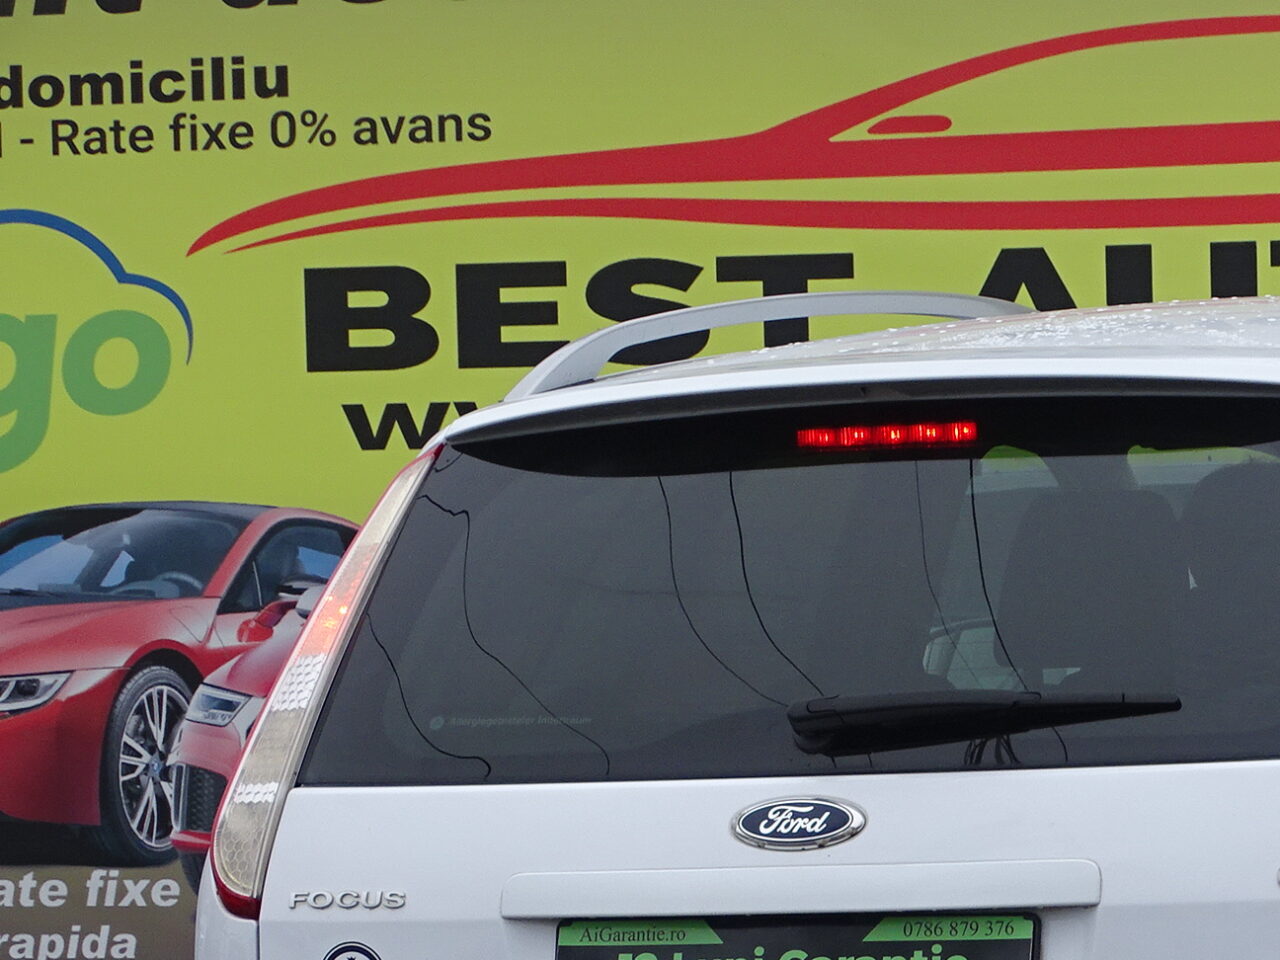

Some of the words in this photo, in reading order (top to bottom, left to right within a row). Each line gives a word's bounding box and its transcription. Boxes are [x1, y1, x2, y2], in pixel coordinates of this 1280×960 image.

[51, 118, 154, 156] Rate
[169, 112, 254, 153] fixe
[270, 109, 337, 149] 0%
[353, 110, 493, 146] avans
[304, 252, 854, 373] BEST
[758, 805, 831, 834] Ford
[86, 869, 181, 907] fixe
[289, 890, 406, 910] FOCUS
[579, 926, 687, 943] AiGarantie.ro
[903, 921, 944, 937] 0786
[949, 921, 980, 937] 879
[984, 920, 1015, 936] 376
